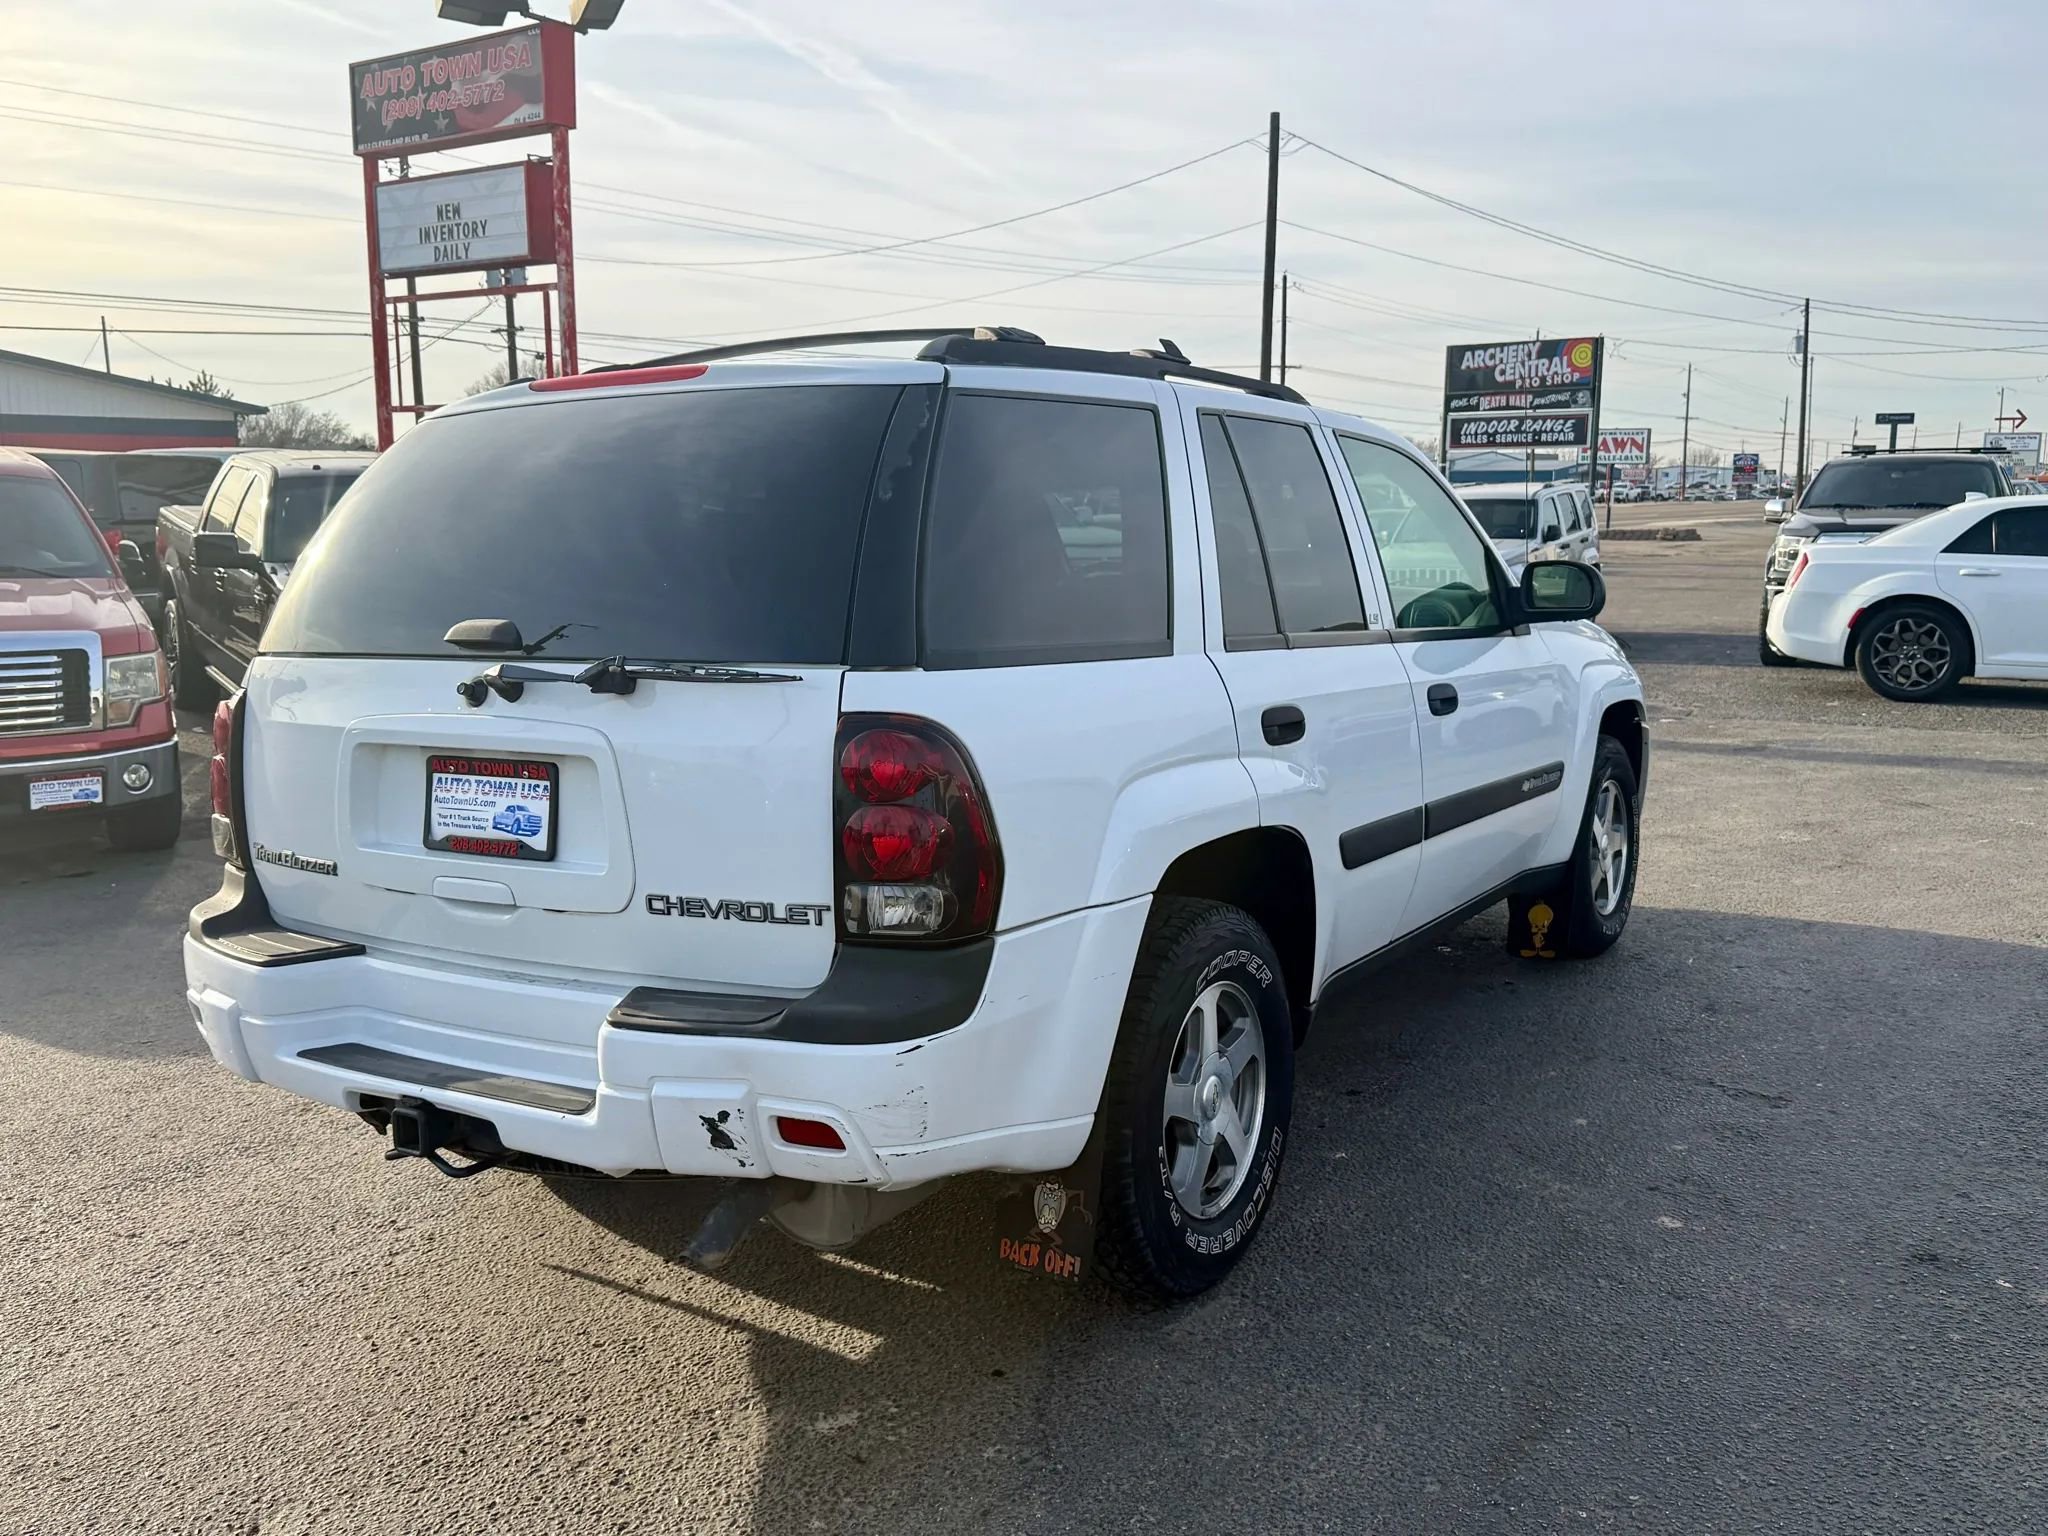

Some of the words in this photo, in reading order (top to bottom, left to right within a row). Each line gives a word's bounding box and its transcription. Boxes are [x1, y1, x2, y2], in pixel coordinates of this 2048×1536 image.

[360, 65, 415, 98] AUTO
[421, 51, 482, 87] TOWN
[488, 41, 532, 74] USA
[382, 95, 422, 126] (208)
[427, 80, 505, 112] 402-5772
[437, 202, 461, 222] NEW
[419, 219, 488, 244] INVENTORY
[434, 242, 470, 262] DAILY
[1460, 342, 1541, 370] ARCHERY
[1494, 356, 1571, 382] CENTRAL
[1515, 377, 1540, 389] PRO
[1546, 372, 1580, 386] SHOP
[1480, 395, 1507, 411] DEATH
[1460, 419, 1519, 435] INDOOR
[1521, 419, 1576, 432] RANGE
[1460, 435, 1488, 444] SALES
[1495, 433, 1533, 443] SERVICE
[1541, 432, 1575, 442] REPAIR
[1598, 437, 1645, 454] AWN
[432, 759, 469, 773] AUTO
[472, 761, 515, 777] TOWN
[519, 764, 549, 779] USA
[32, 783, 55, 791] AUTO
[434, 776, 472, 794] AUTO
[474, 779, 518, 798] TOWN
[519, 782, 550, 800] USA
[434, 795, 496, 808] AutoTownUS.com
[645, 893, 831, 926] CHEVROLET
[1195, 949, 1273, 996] COOPER
[1185, 1126, 1283, 1254] DISCOVERER
[1000, 1238, 1041, 1267] BACK
[1045, 1248, 1081, 1282] OFF!
